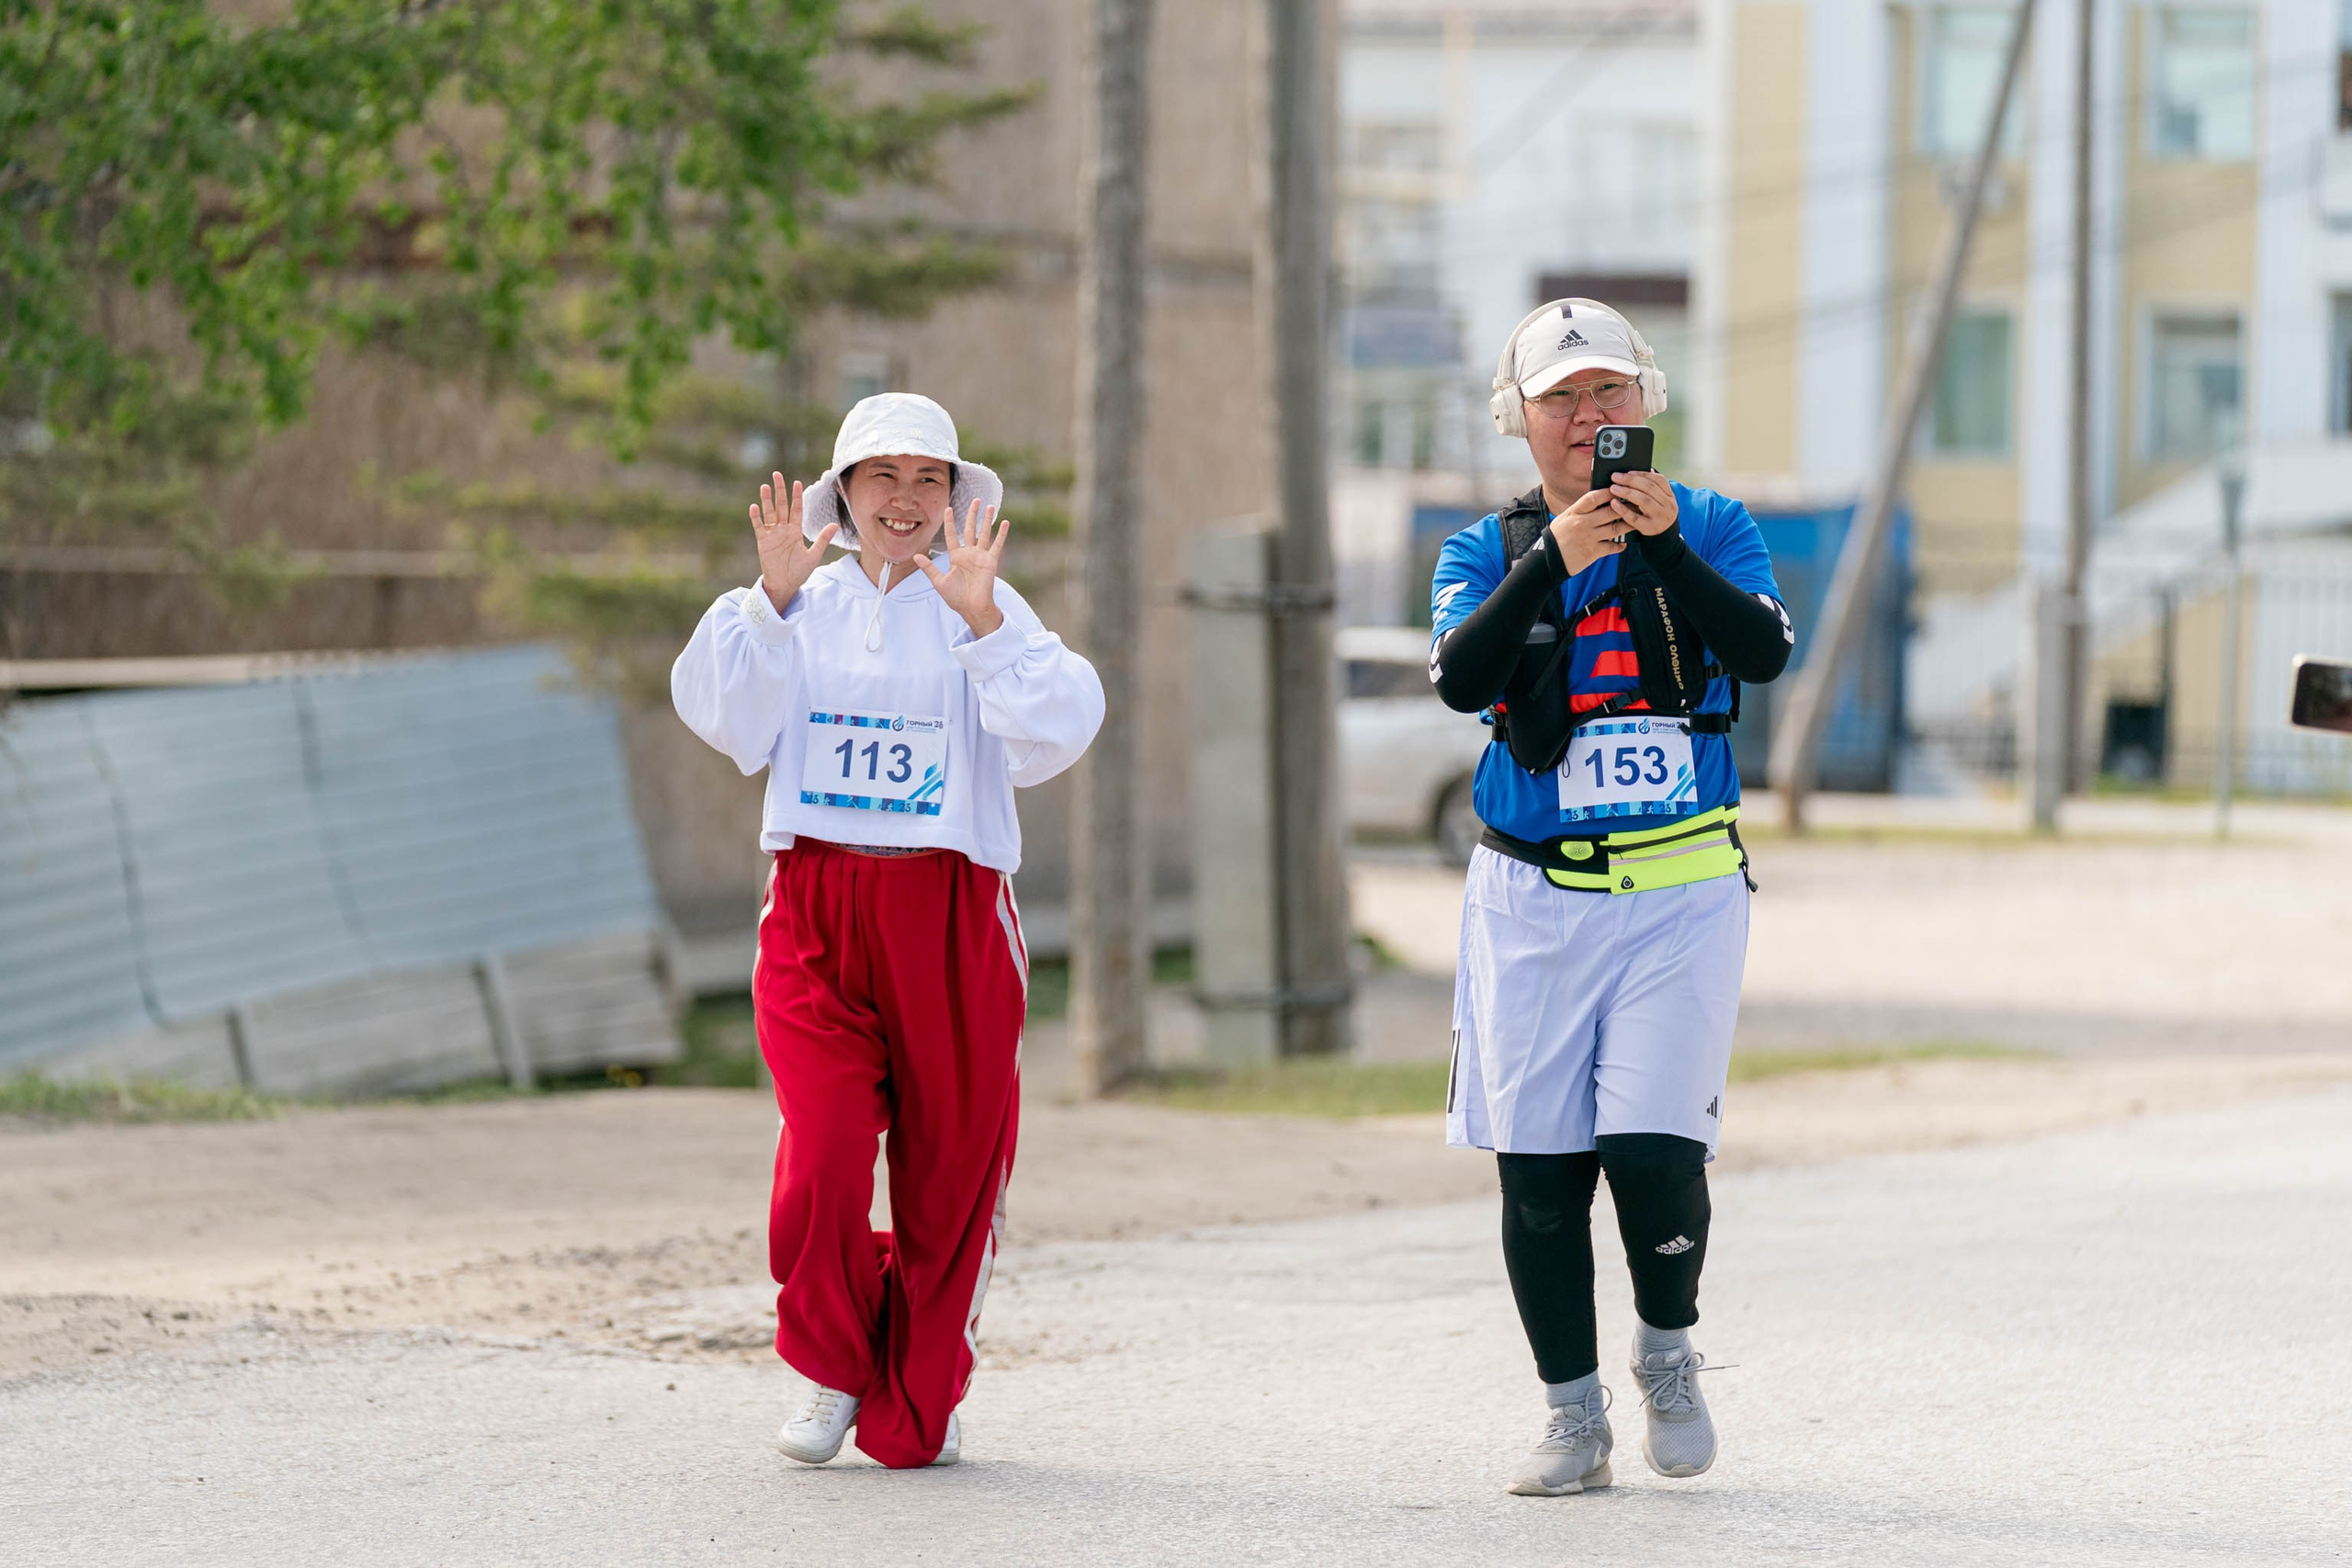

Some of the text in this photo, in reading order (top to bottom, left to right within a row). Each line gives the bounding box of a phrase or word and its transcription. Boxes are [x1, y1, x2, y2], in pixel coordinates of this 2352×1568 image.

[1557, 339, 1589, 351] adidas
[1655, 587, 1675, 642] МАРАФОН
[906, 719, 933, 728] ГОРНЫЙ
[834, 739, 912, 783] 113
[1585, 746, 1668, 788] 153
[1655, 1240, 1695, 1255] adidas
